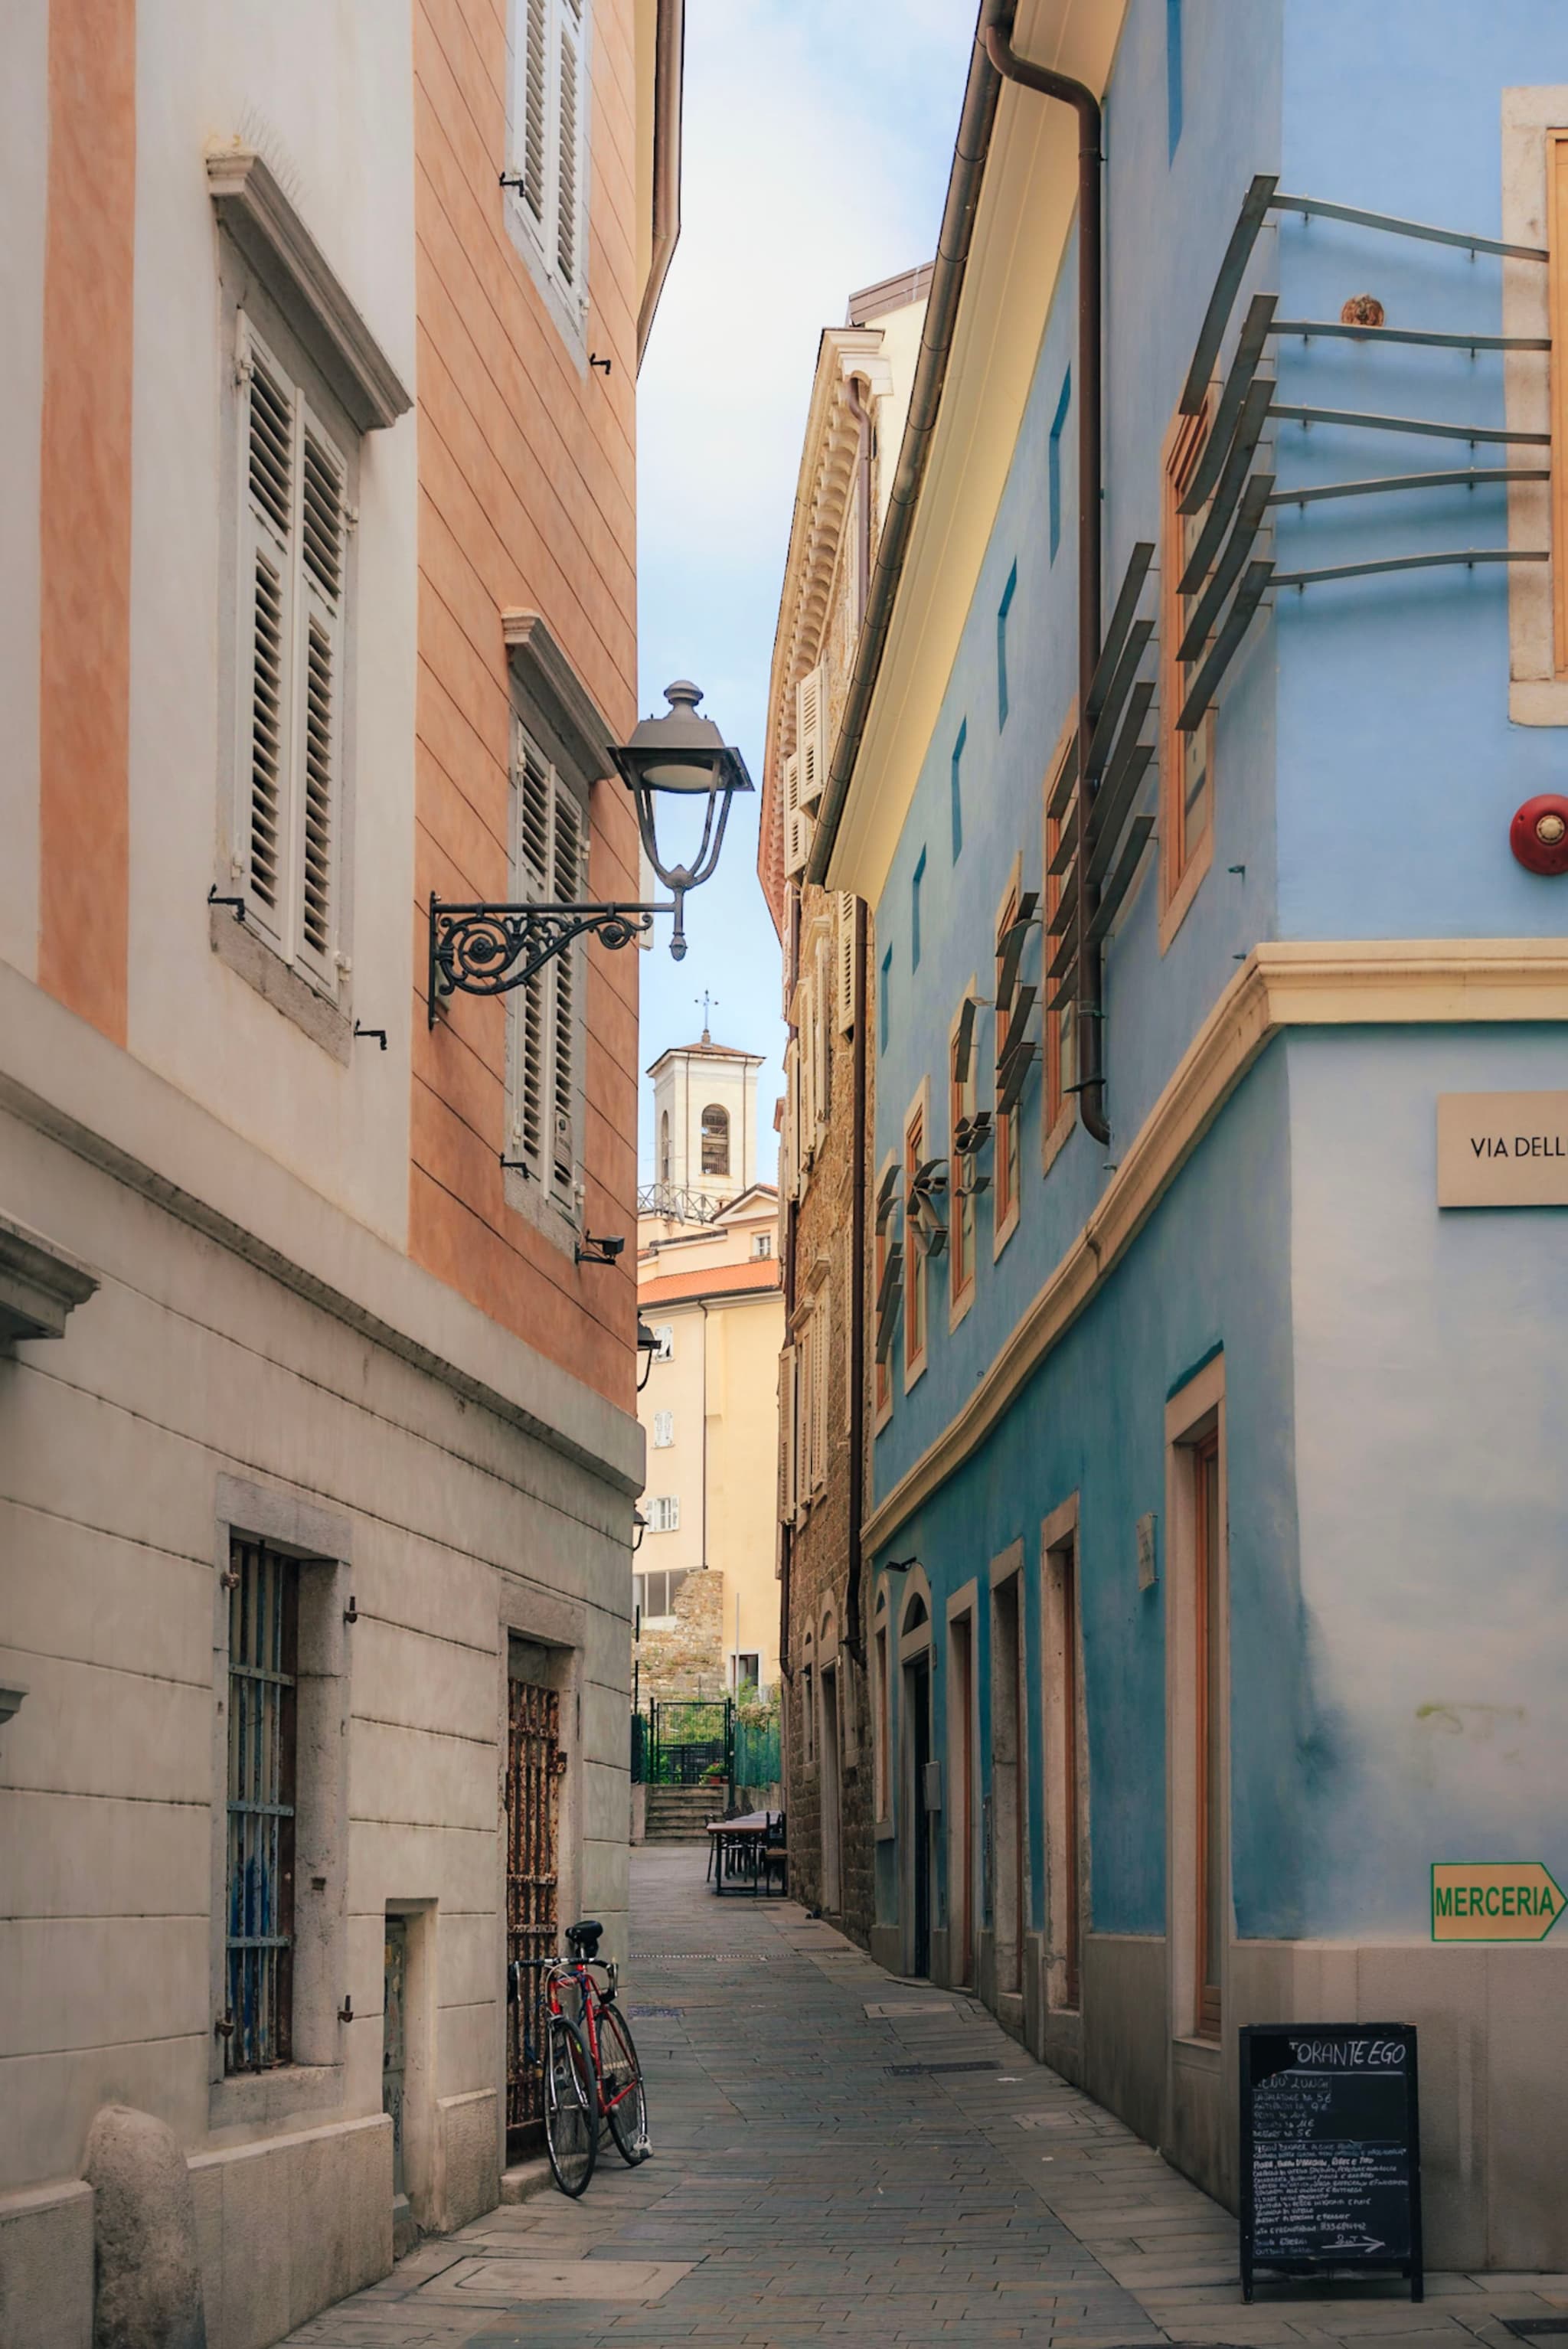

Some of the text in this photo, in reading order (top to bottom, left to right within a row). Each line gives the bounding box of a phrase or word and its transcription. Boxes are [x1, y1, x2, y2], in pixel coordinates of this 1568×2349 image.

[1471, 1136, 1568, 1158] VIA DELL
[1436, 1886, 1555, 1916] MERCERIA
[1367, 2040, 1406, 2064] EGO
